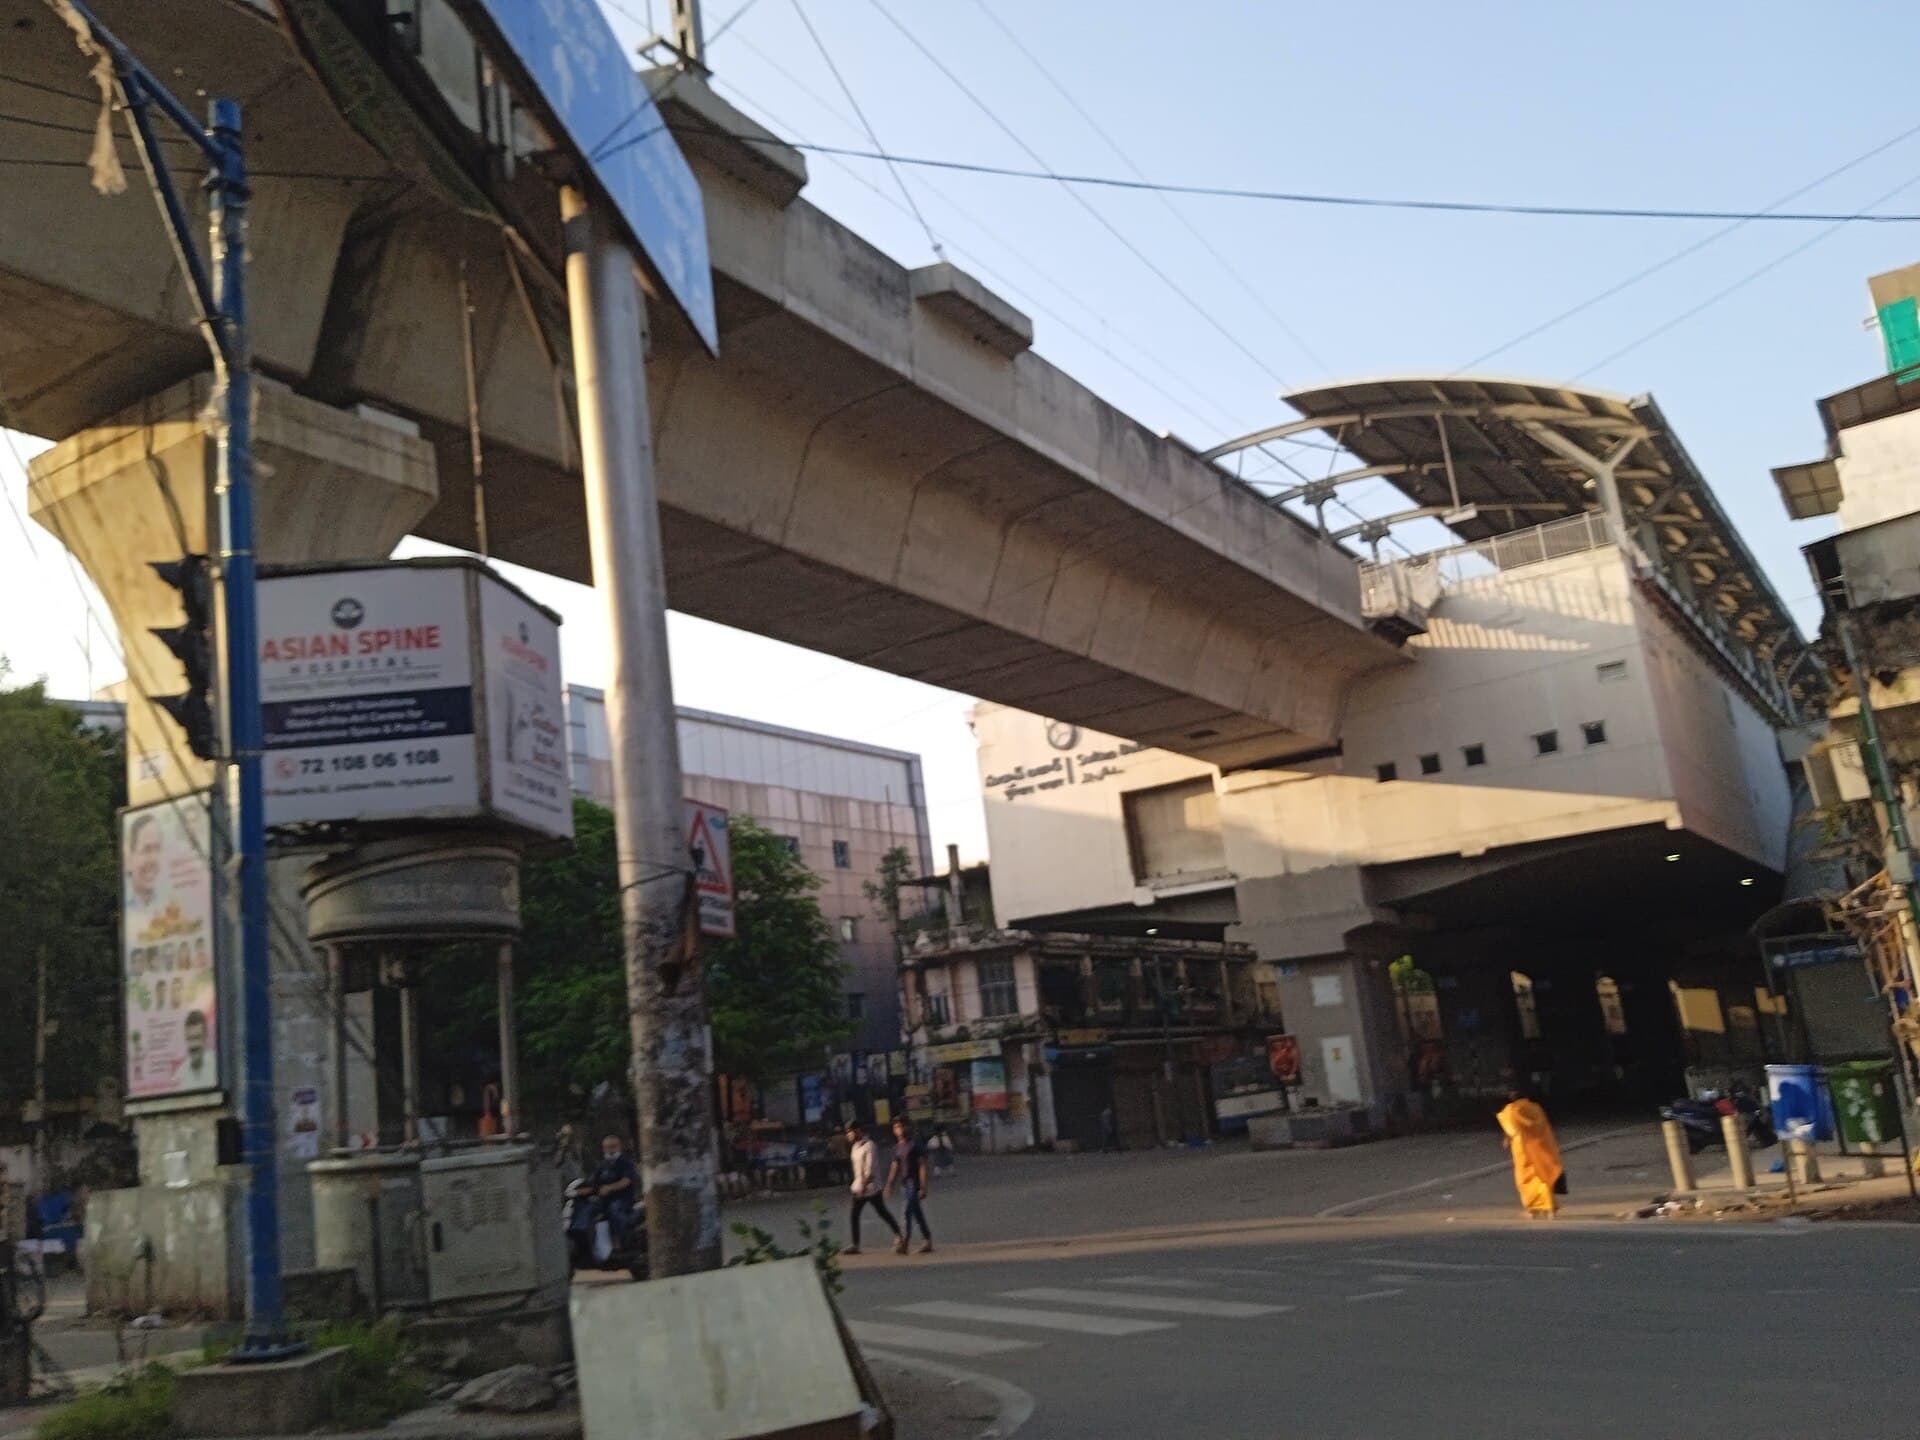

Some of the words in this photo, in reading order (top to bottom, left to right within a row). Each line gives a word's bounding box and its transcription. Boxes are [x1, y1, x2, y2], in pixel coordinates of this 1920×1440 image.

[261, 633, 350, 663] ASIAN
[357, 625, 442, 655] SPINE
[289, 656, 411, 674] HOSPITAL
[299, 758, 325, 775] 72
